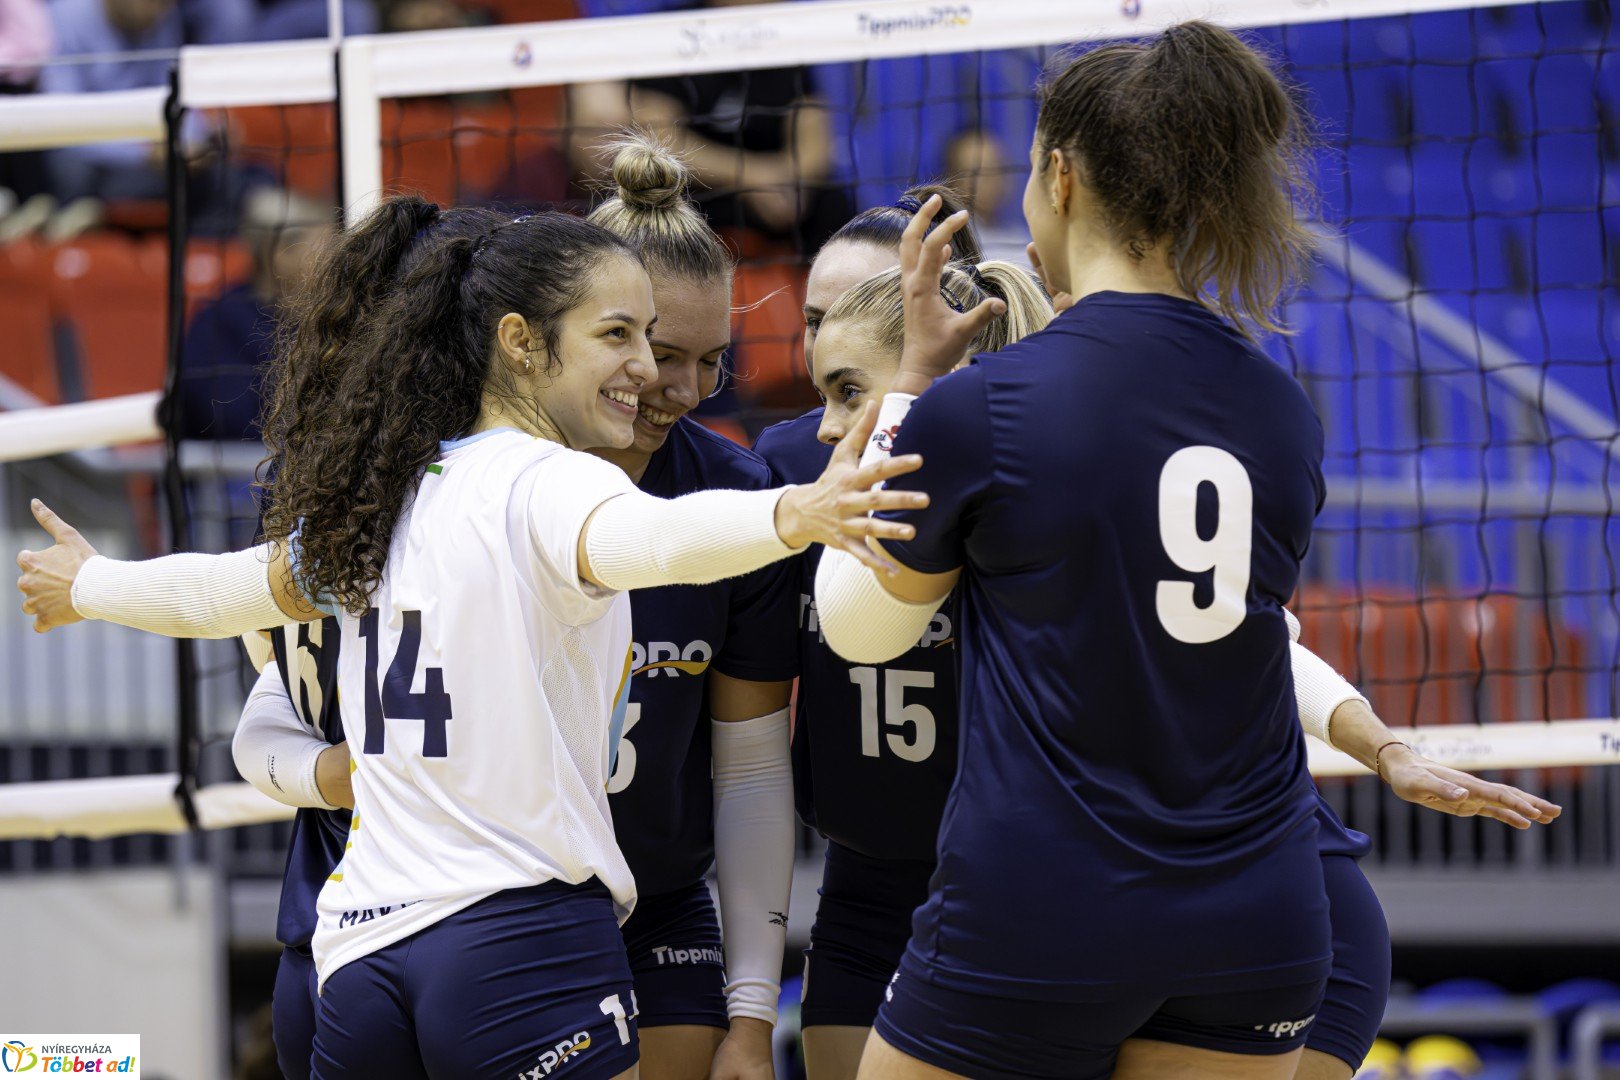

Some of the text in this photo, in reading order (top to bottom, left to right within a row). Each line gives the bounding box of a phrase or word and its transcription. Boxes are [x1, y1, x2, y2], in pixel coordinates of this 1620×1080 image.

[1156, 445, 1253, 644] 9
[359, 607, 453, 757] 14
[849, 666, 936, 762] 15
